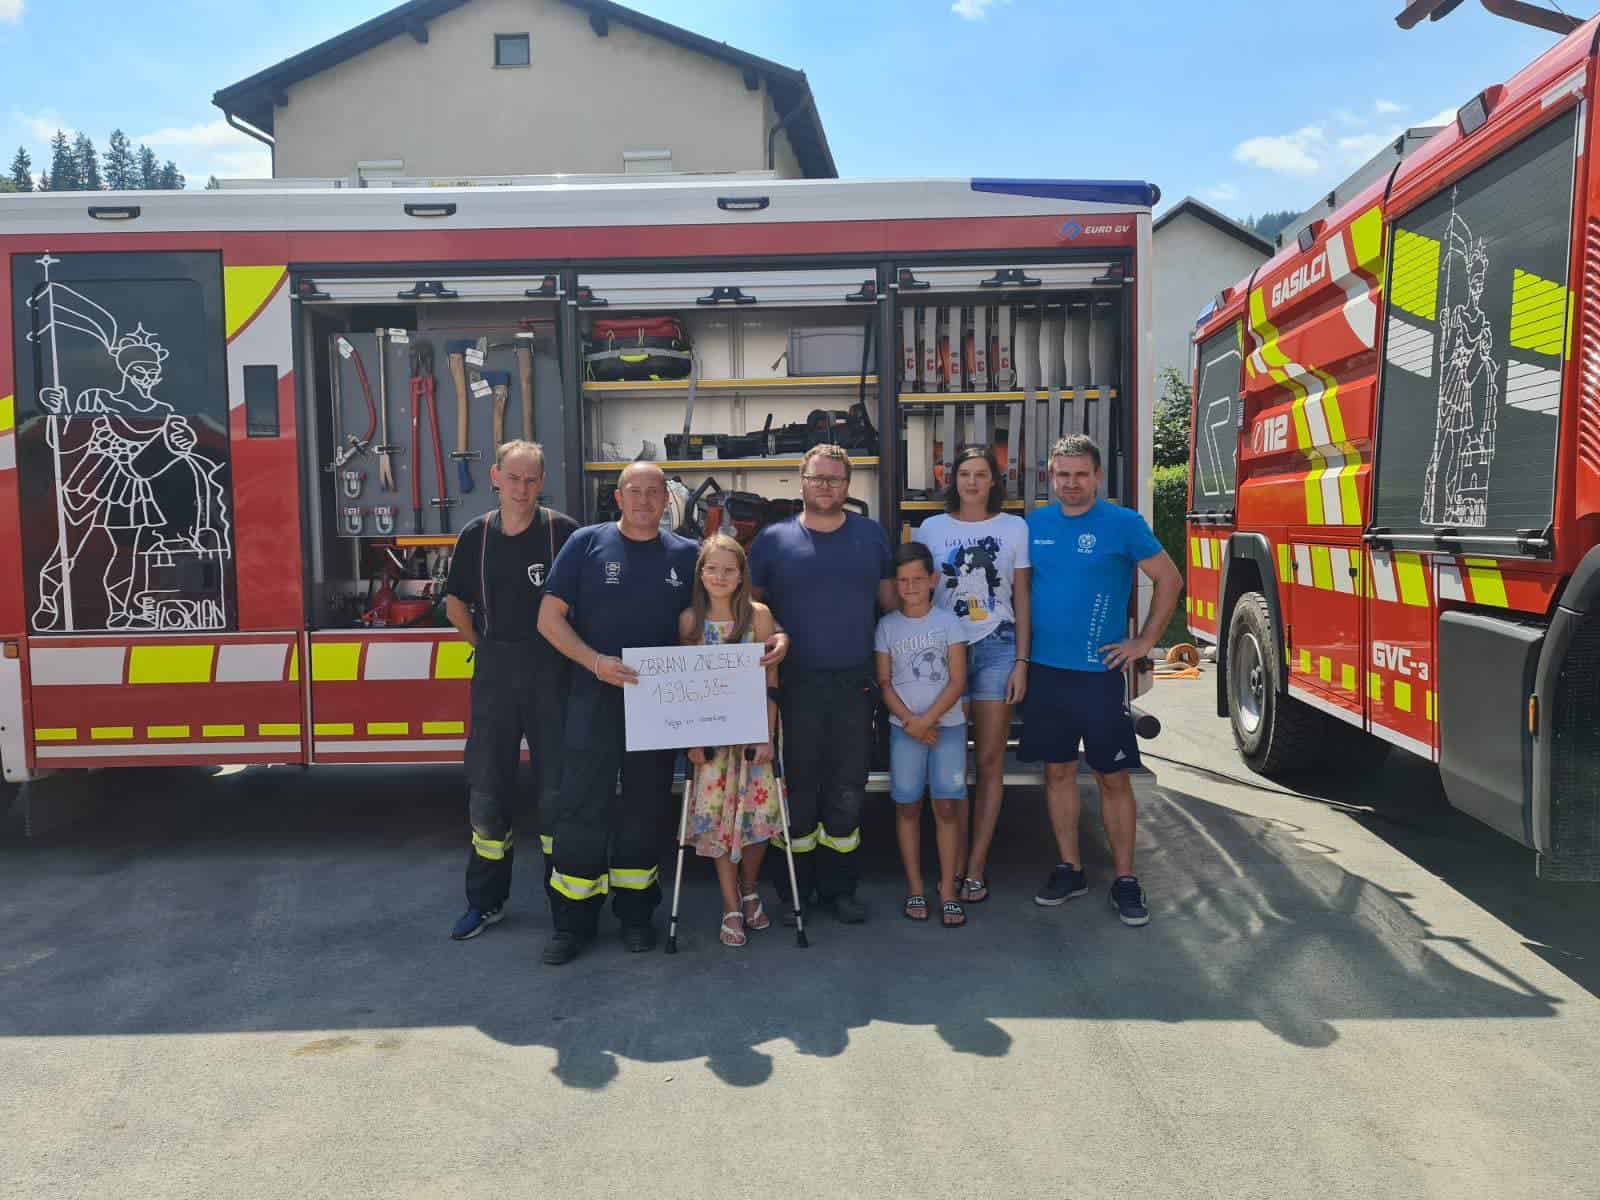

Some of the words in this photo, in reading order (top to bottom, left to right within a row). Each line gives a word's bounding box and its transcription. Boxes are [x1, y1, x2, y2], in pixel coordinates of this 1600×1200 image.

[1084, 225, 1112, 235] EURO
[1271, 251, 1328, 308] GASILCI
[1263, 413, 1289, 454] 112
[1372, 640, 1430, 682] GVC-3
